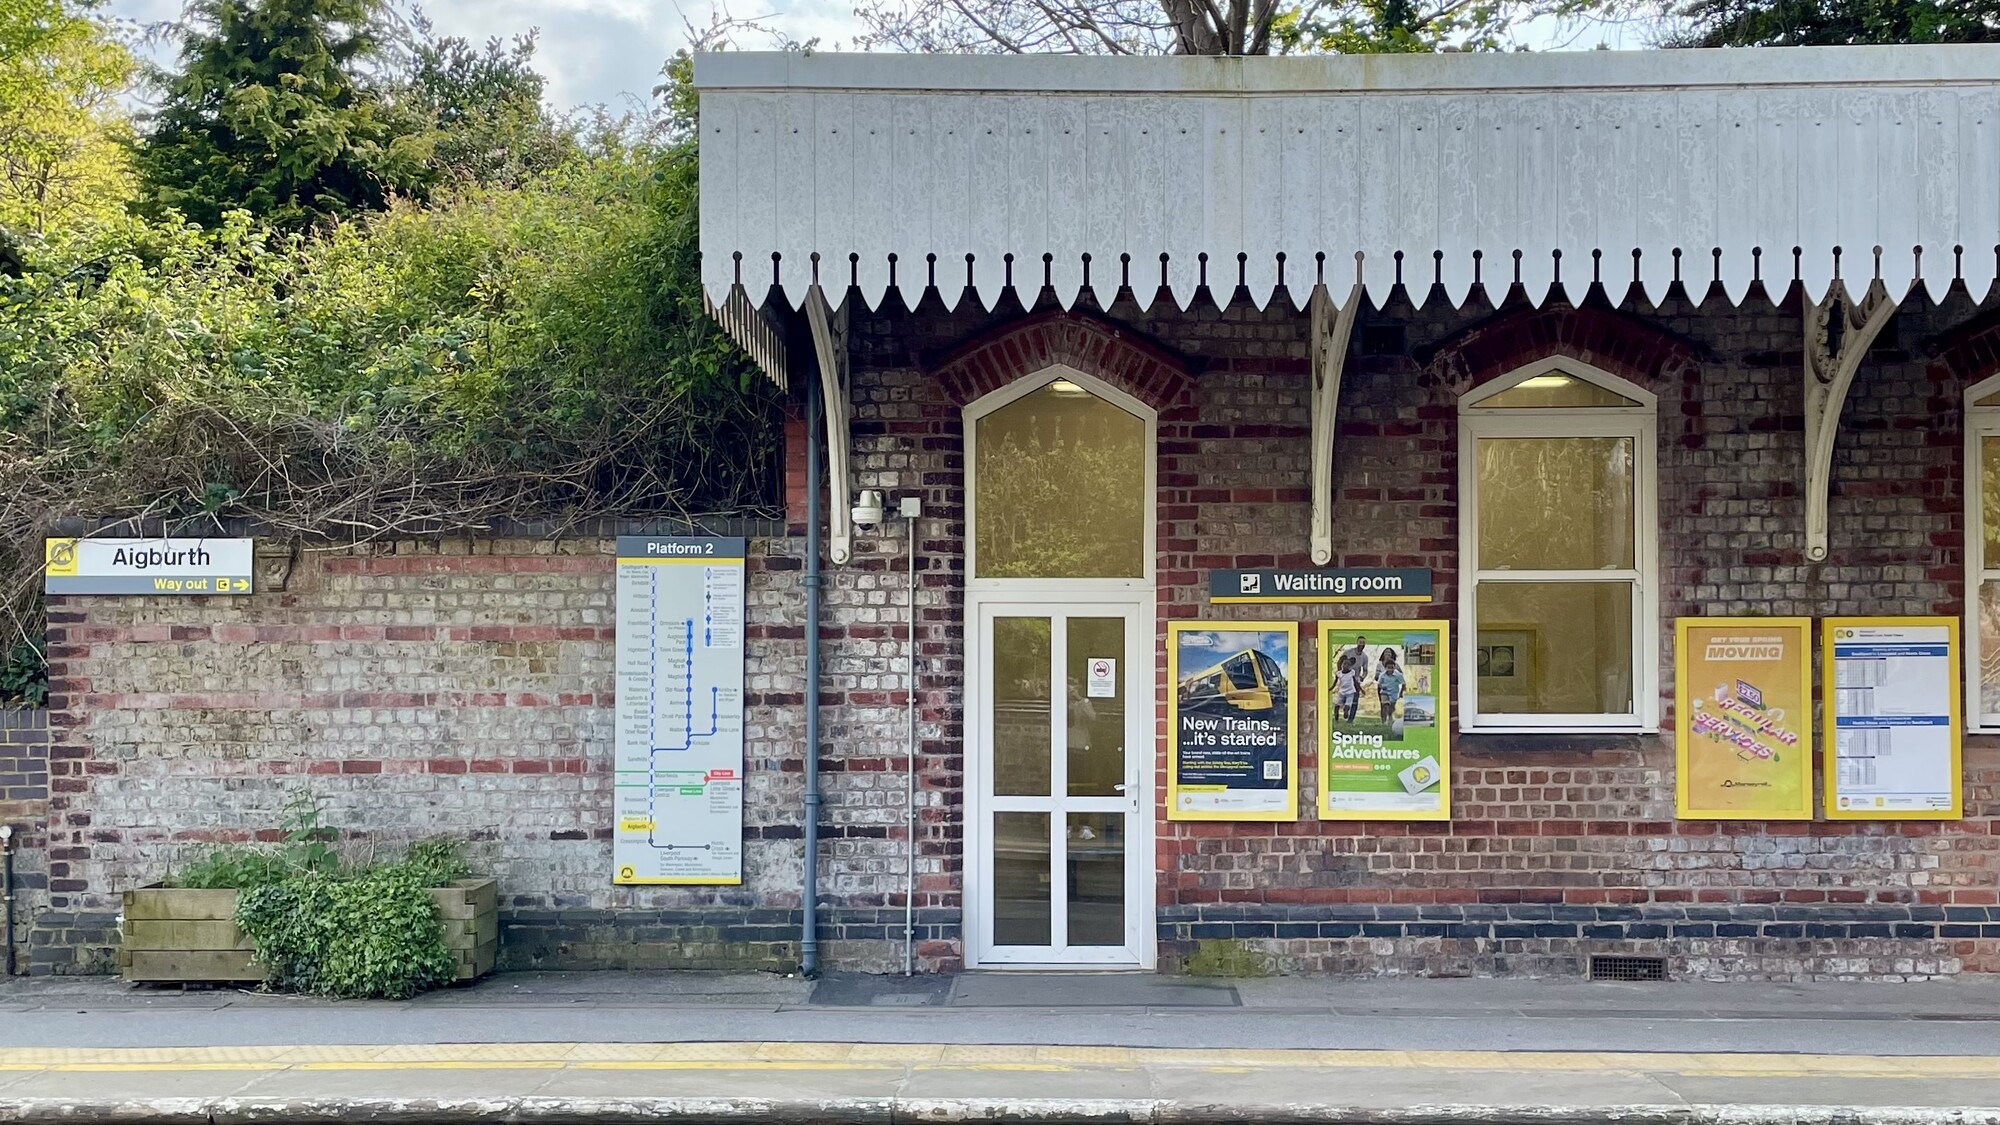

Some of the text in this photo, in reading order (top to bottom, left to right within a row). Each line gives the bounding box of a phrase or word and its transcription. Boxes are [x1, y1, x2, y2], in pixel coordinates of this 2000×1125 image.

[647, 542, 714, 554] Platform 2
[112, 548, 210, 568] Aigburth
[154, 578, 208, 592] Way out
[1274, 574, 1402, 594] Waiting room
[1708, 647, 1780, 658] MOVING
[1182, 716, 1280, 731] New Trains...
[1718, 698, 1797, 746] REGULAR
[1221, 732, 1276, 746] started
[1332, 731, 1383, 748] Spring
[1696, 712, 1773, 760] SERVICES
[1332, 746, 1420, 759] Adventures
